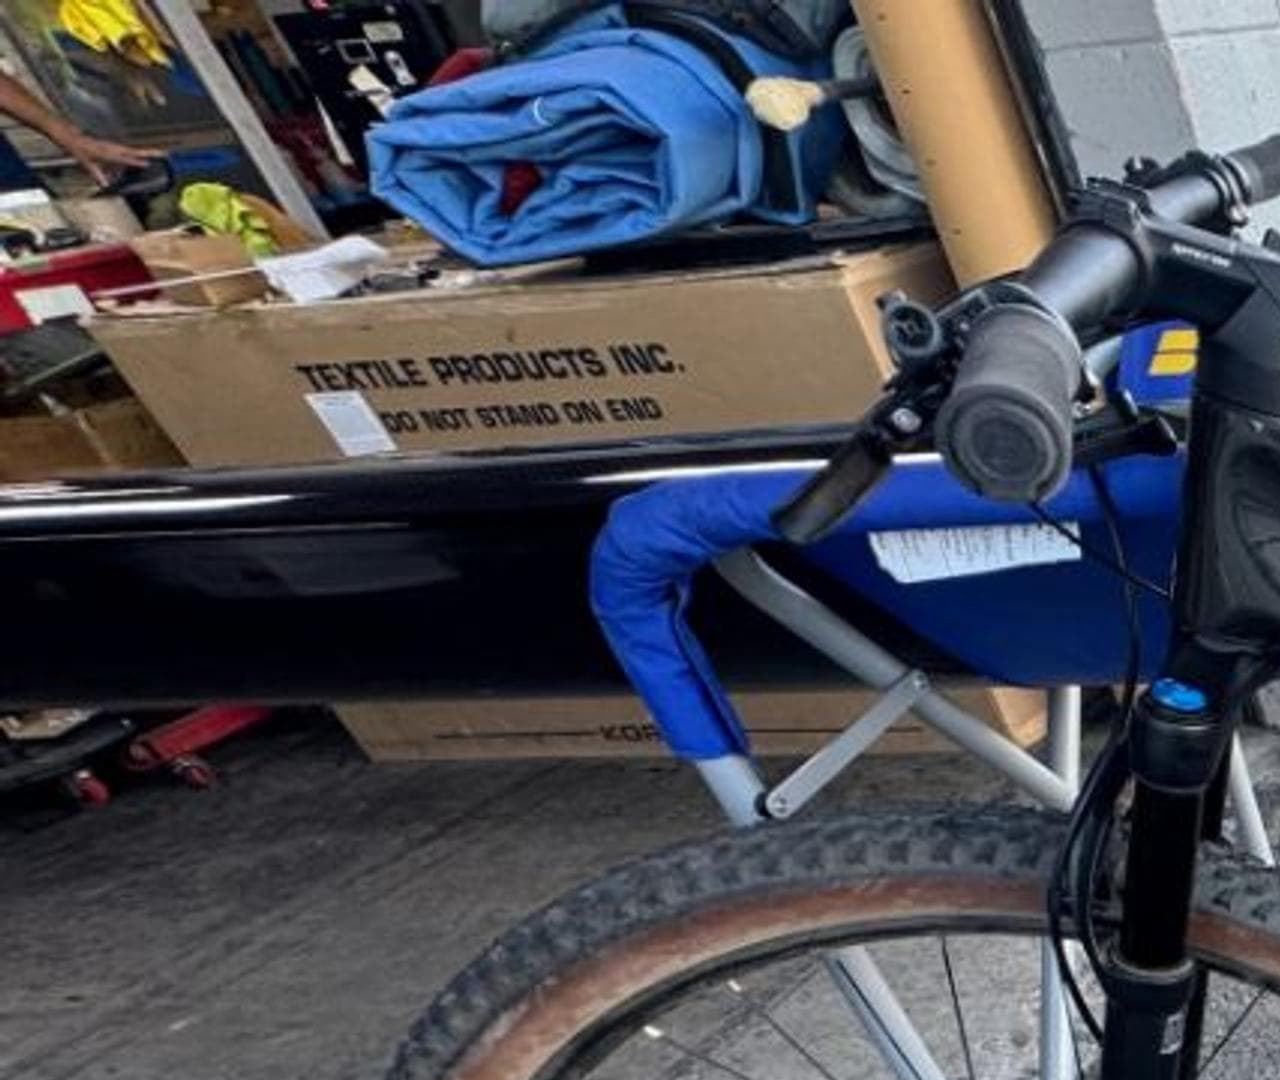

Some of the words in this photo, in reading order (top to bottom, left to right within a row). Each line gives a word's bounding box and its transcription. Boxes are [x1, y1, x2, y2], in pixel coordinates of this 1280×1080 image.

[295, 359, 427, 392] TEXTILE
[429, 347, 608, 385] PRODUCTS
[608, 342, 686, 376] INC.
[381, 409, 418, 433] DO
[421, 407, 472, 431] NOT
[478, 402, 560, 428] STAND
[562, 400, 606, 423] ON
[609, 396, 664, 421] END
